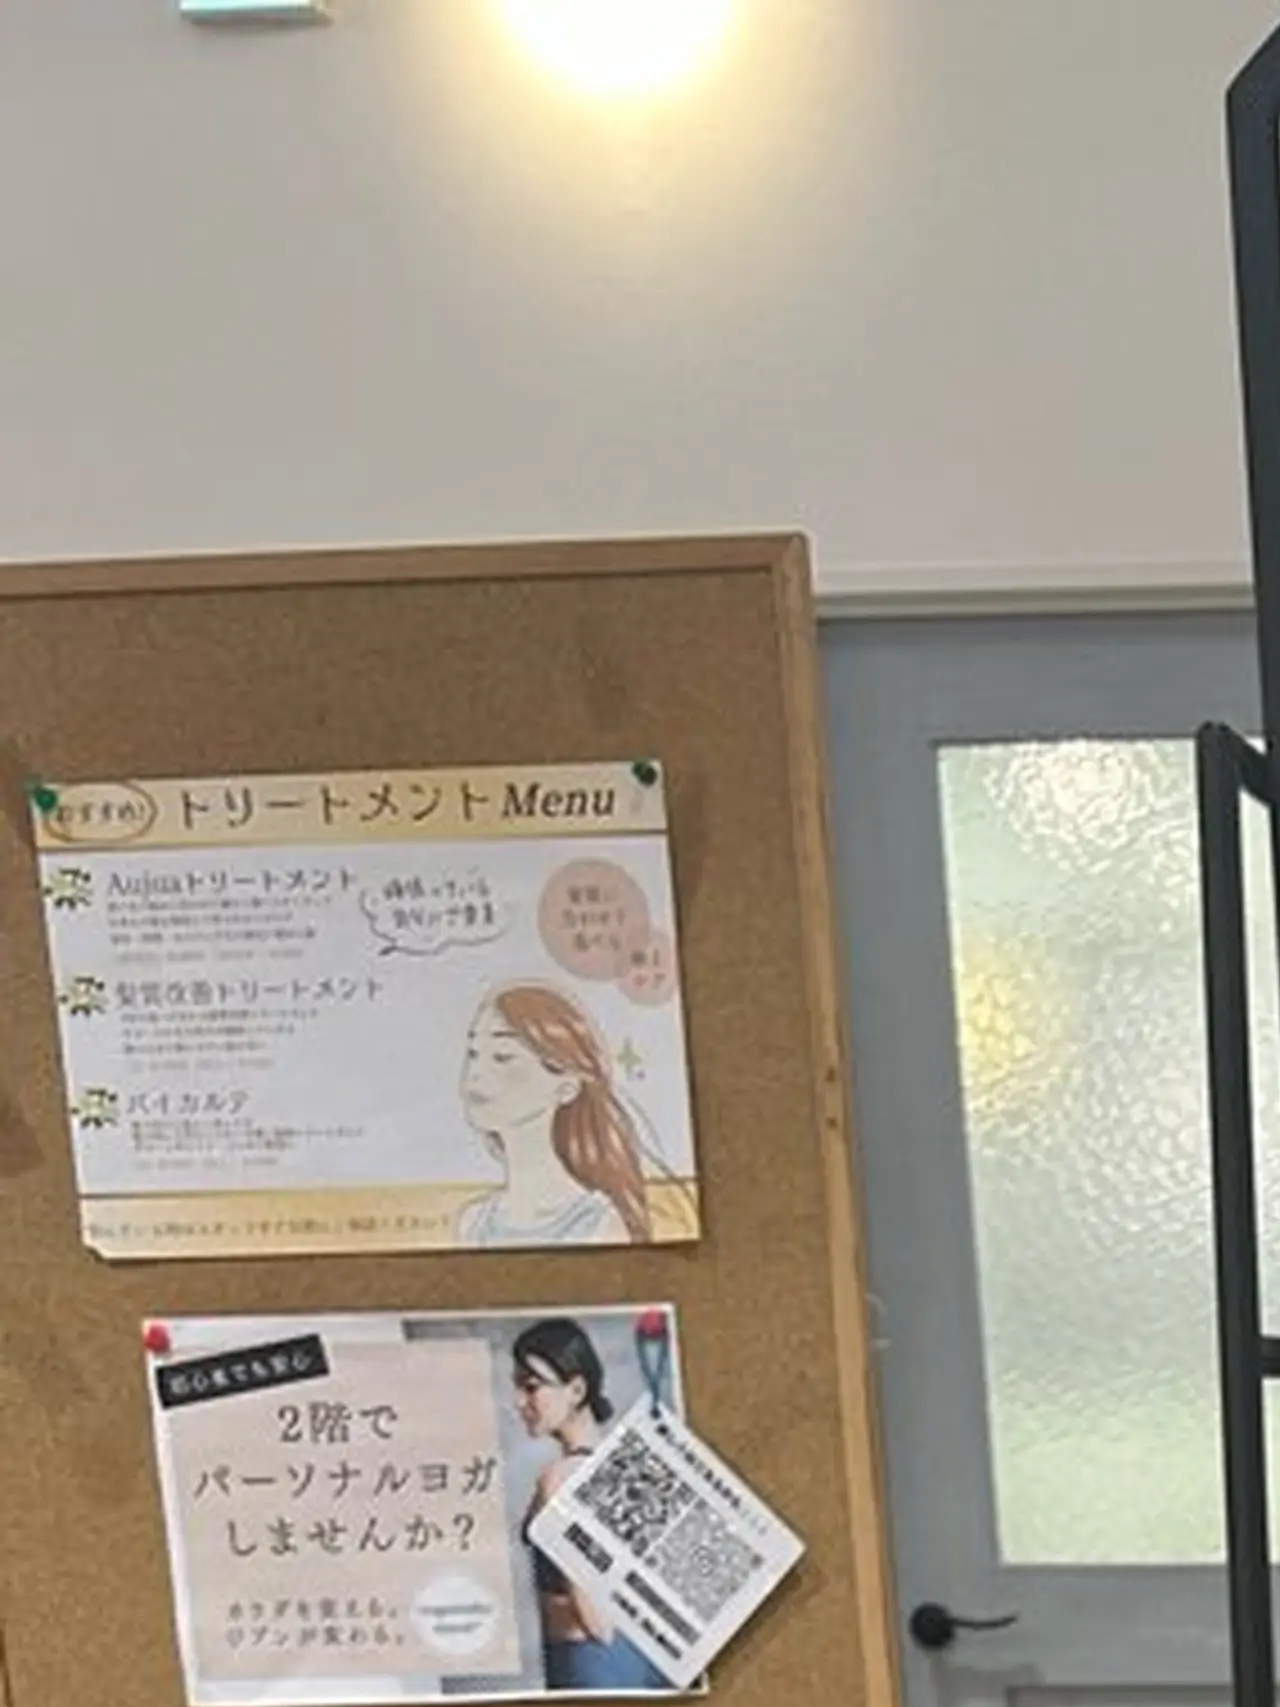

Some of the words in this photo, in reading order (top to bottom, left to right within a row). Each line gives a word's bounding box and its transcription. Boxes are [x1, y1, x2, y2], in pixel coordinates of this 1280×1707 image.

[502, 780, 615, 818] Menu
[278, 1402, 398, 1443] 2階で
[194, 1455, 497, 1499] パーソナルヨガ
